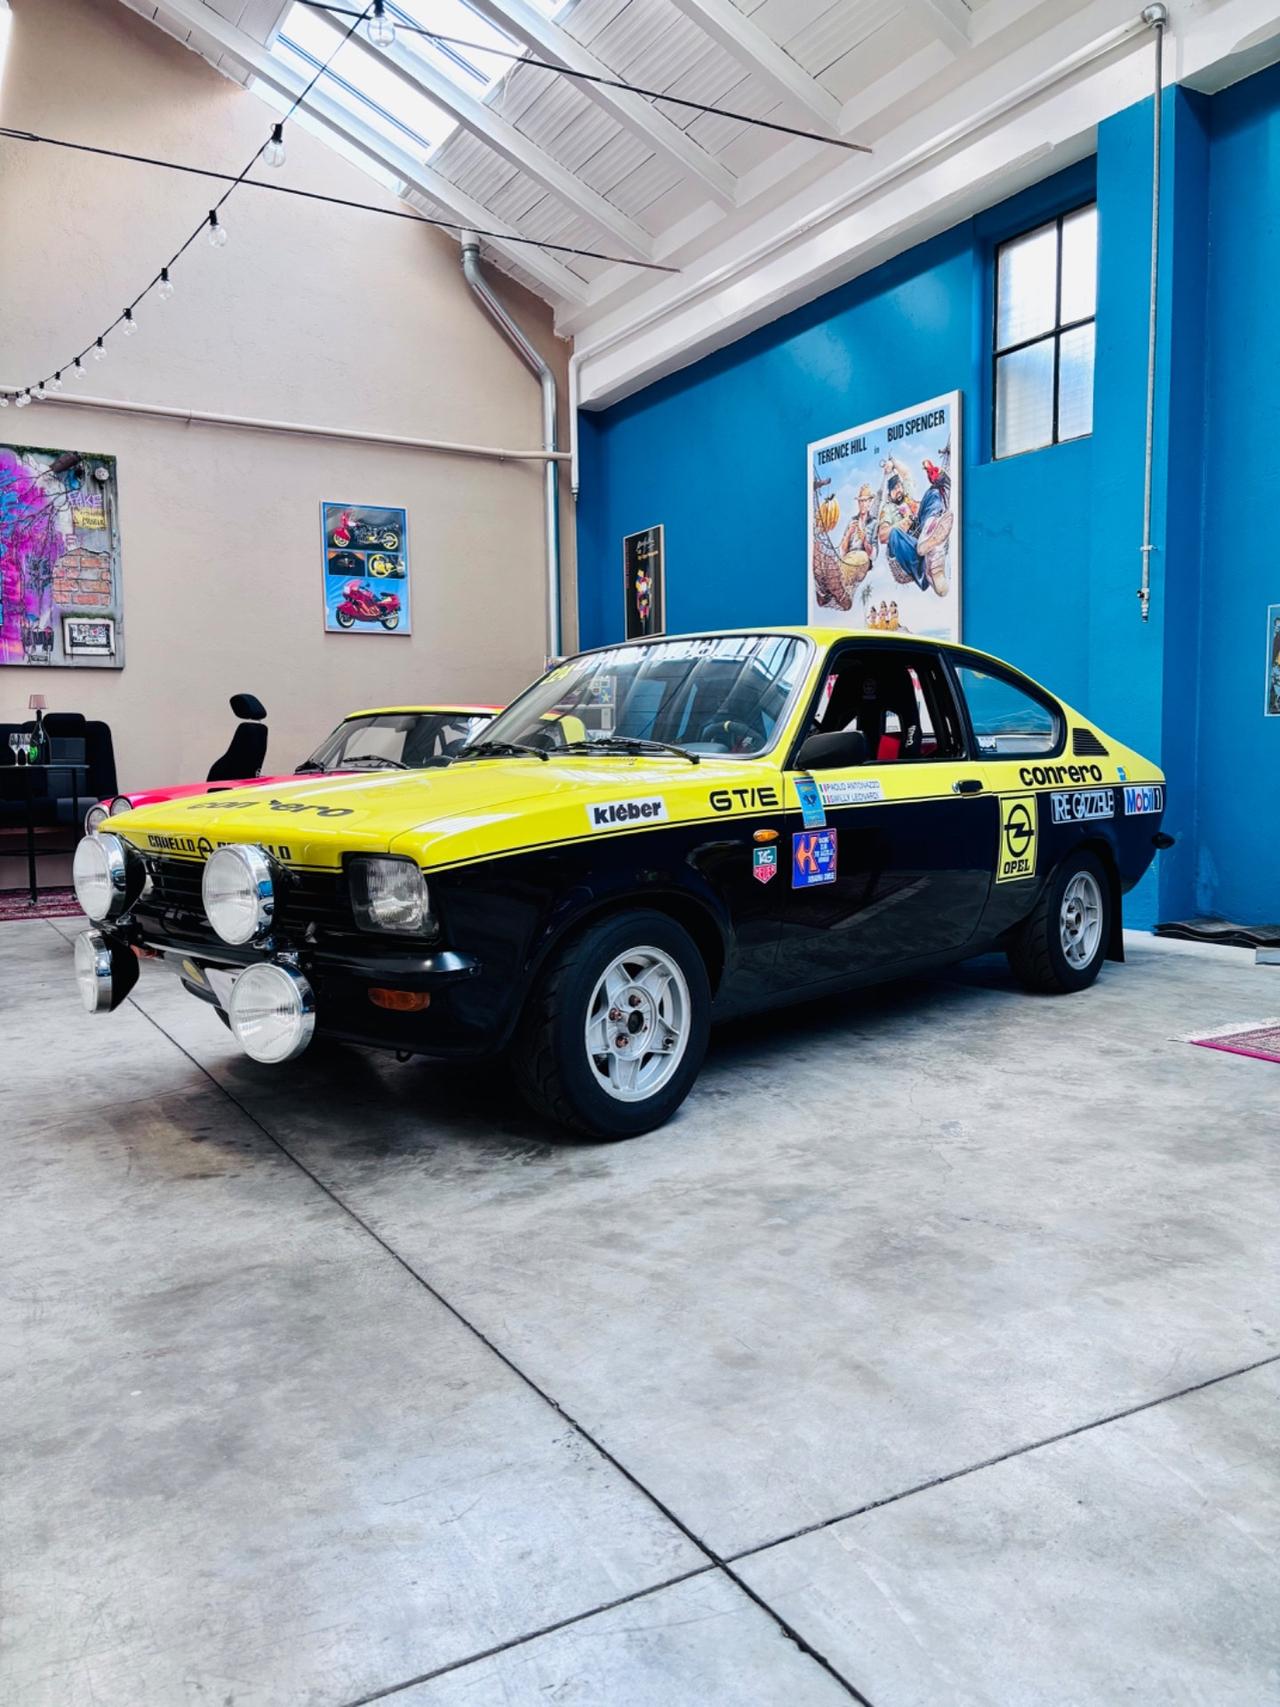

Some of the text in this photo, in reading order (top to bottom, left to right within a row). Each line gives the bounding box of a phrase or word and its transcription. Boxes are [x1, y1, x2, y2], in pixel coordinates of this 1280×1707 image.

[818, 443, 849, 465] TERENCE
[851, 437, 867, 454] HILL
[887, 424, 904, 442] BUD
[905, 409, 945, 436] SPENCER
[1019, 764, 1102, 787] conrero
[709, 786, 779, 812] GT/E
[1052, 792, 1071, 821] TRE
[1124, 788, 1155, 814] Mobil
[593, 801, 662, 825] kléber
[1003, 859, 1030, 874] OPEL
